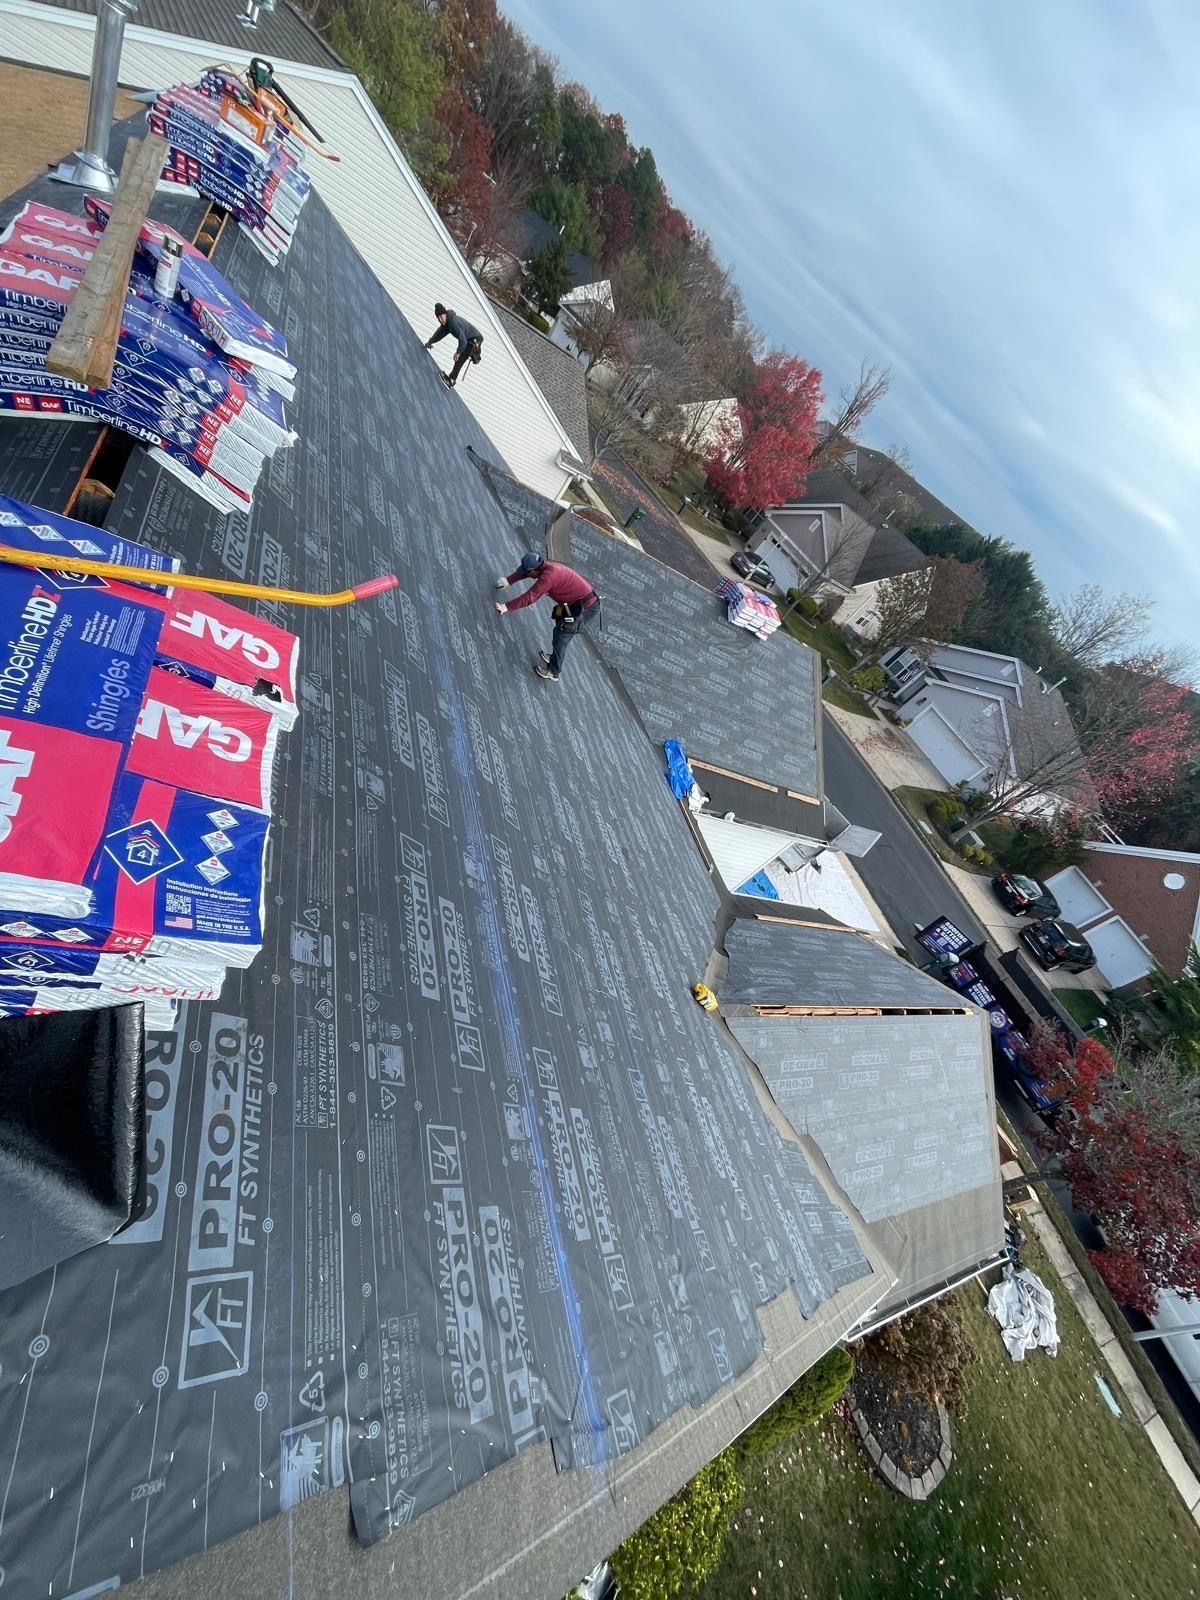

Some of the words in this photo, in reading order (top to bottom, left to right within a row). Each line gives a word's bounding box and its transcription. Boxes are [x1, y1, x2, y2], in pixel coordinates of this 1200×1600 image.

[15, 396, 32, 405] NE
[56, 613, 73, 641] Shingles
[170, 609, 280, 670] GAF
[86, 657, 131, 733] Shingles
[394, 687, 413, 769] PRO-20
[418, 715, 438, 791] PRO-20
[404, 895, 420, 986] SYNTHETICS
[414, 882, 437, 992] PRO-20
[454, 911, 473, 1001] SYNTHETICS
[502, 865, 527, 956] PRO-20
[368, 936, 376, 992] SYNTHETICS
[442, 904, 469, 1018] PRO-20
[317, 1021, 328, 1094] SYNTHETICS
[319, 1095, 327, 1111] FT
[328, 1022, 336, 1129] 1-844-353-9839
[779, 1078, 812, 1089] PRO-20
[198, 1027, 242, 1249] PRO-20
[240, 1033, 265, 1199] SYNTHETICS
[550, 1122, 576, 1231] SYNTHETICS
[552, 1098, 587, 1230] PRO-20
[572, 1116, 612, 1247] PRO-20
[583, 1117, 612, 1225] SYNTHETICS
[855, 1166, 882, 1179] PRO-20
[238, 1206, 256, 1246] FT
[432, 1199, 446, 1232] FT
[437, 1238, 466, 1410] SYNTHETICS
[446, 1200, 487, 1404] PRO-20
[484, 1222, 528, 1417] PRO-20
[500, 1216, 535, 1364] SYNTHETICS
[309, 1390, 319, 1400] 5
[390, 1341, 400, 1359] FT
[380, 1320, 398, 1485] 1-844-353-9839
[392, 1365, 409, 1479] SYNTHETICS
